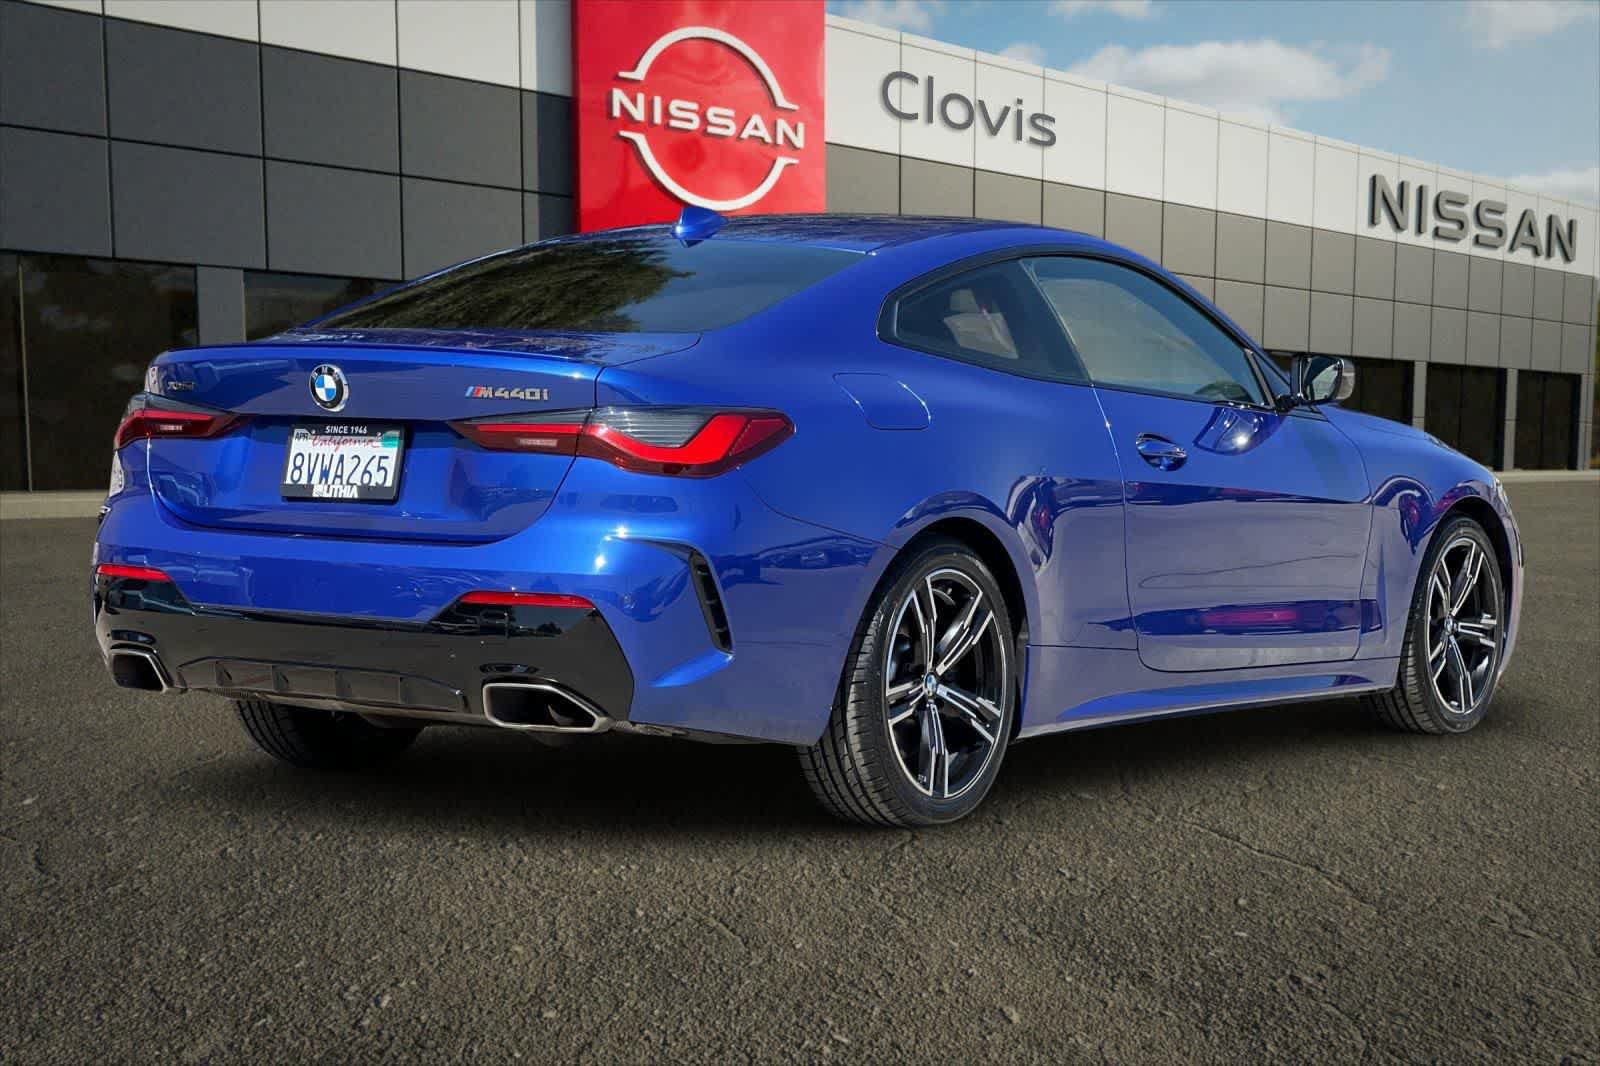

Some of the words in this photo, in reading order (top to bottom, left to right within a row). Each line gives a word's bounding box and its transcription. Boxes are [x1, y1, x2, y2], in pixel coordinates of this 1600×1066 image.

[612, 88, 804, 148] NISSAN
[878, 71, 1056, 147] Clovis
[1369, 174, 1577, 264] NISSAN
[311, 434, 381, 452] California
[325, 425, 347, 434] SINCE
[290, 452, 389, 486] 8VWA265
[322, 484, 359, 498] LITHIA
